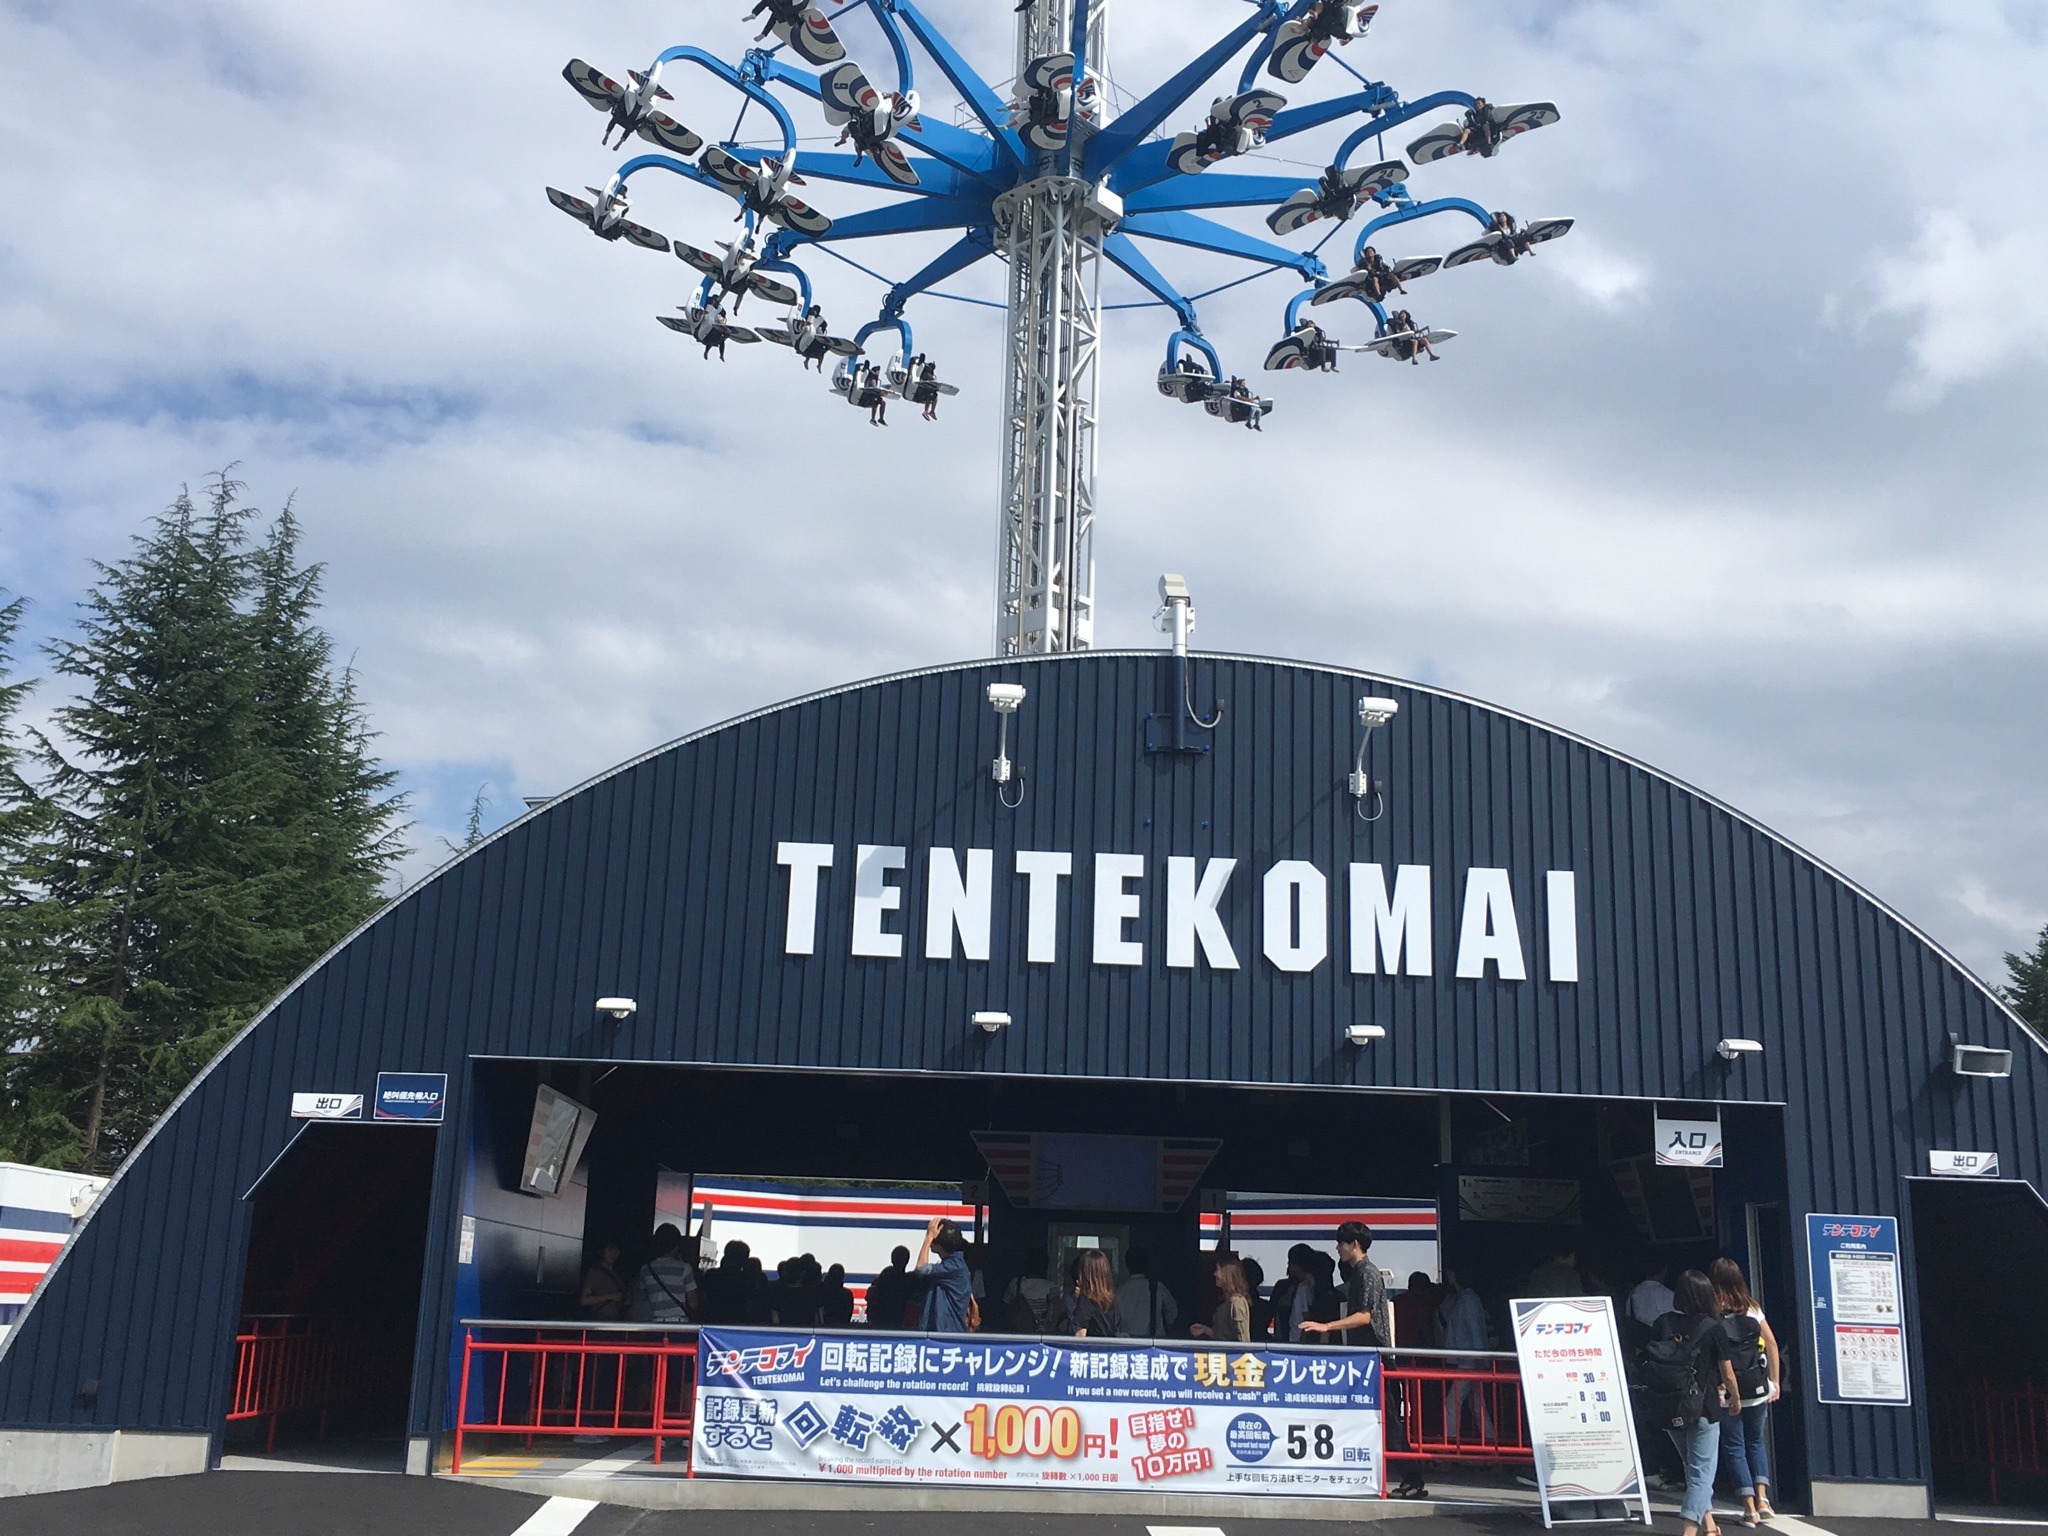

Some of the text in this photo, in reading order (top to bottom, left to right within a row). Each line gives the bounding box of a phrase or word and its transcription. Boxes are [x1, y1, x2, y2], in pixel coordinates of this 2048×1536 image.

[1253, 99, 1263, 109] 2
[1527, 110, 1547, 119] 23
[1378, 169, 1394, 178] 24
[777, 841, 1579, 983] TENTEKOMAI
[315, 1097, 342, 1109] 出口
[1669, 1131, 1707, 1149] 入口
[1953, 1155, 1977, 1167] 出口
[1534, 1348, 1602, 1358] ただ今の待ち時間
[821, 1342, 1062, 1379] 回転記録にチャレンジ！
[752, 1373, 805, 1385] TENTEKOMAI
[820, 1376, 969, 1391] Let's challenge the rotation record!
[1583, 1372, 1595, 1383] 30
[1068, 1385, 1074, 1395] If
[1075, 1387, 1089, 1397] you
[1091, 1386, 1104, 1396] set
[1106, 1388, 1111, 1396] a
[1113, 1389, 1129, 1397] new
[1131, 1388, 1159, 1398] record,
[1162, 1389, 1177, 1399] you
[1178, 1389, 1192, 1398] will
[1195, 1390, 1223, 1399] receive
[1225, 1391, 1231, 1399] a
[1263, 1392, 1279, 1403] gift.
[704, 1396, 777, 1425] 記録更新
[1129, 1408, 1194, 1437] 目指せ！
[1237, 1421, 1262, 1430] 現在の
[704, 1425, 772, 1450] すると
[1148, 1432, 1185, 1454] 夢の
[818, 1455, 843, 1464] Breaking
[1343, 1447, 1371, 1462] 回転
[1132, 1448, 1212, 1480] 10万円！
[856, 1466, 901, 1478] multiplied
[905, 1466, 915, 1478] by
[918, 1466, 932, 1477] the
[935, 1468, 971, 1478] rotation
[974, 1469, 1007, 1479] number
